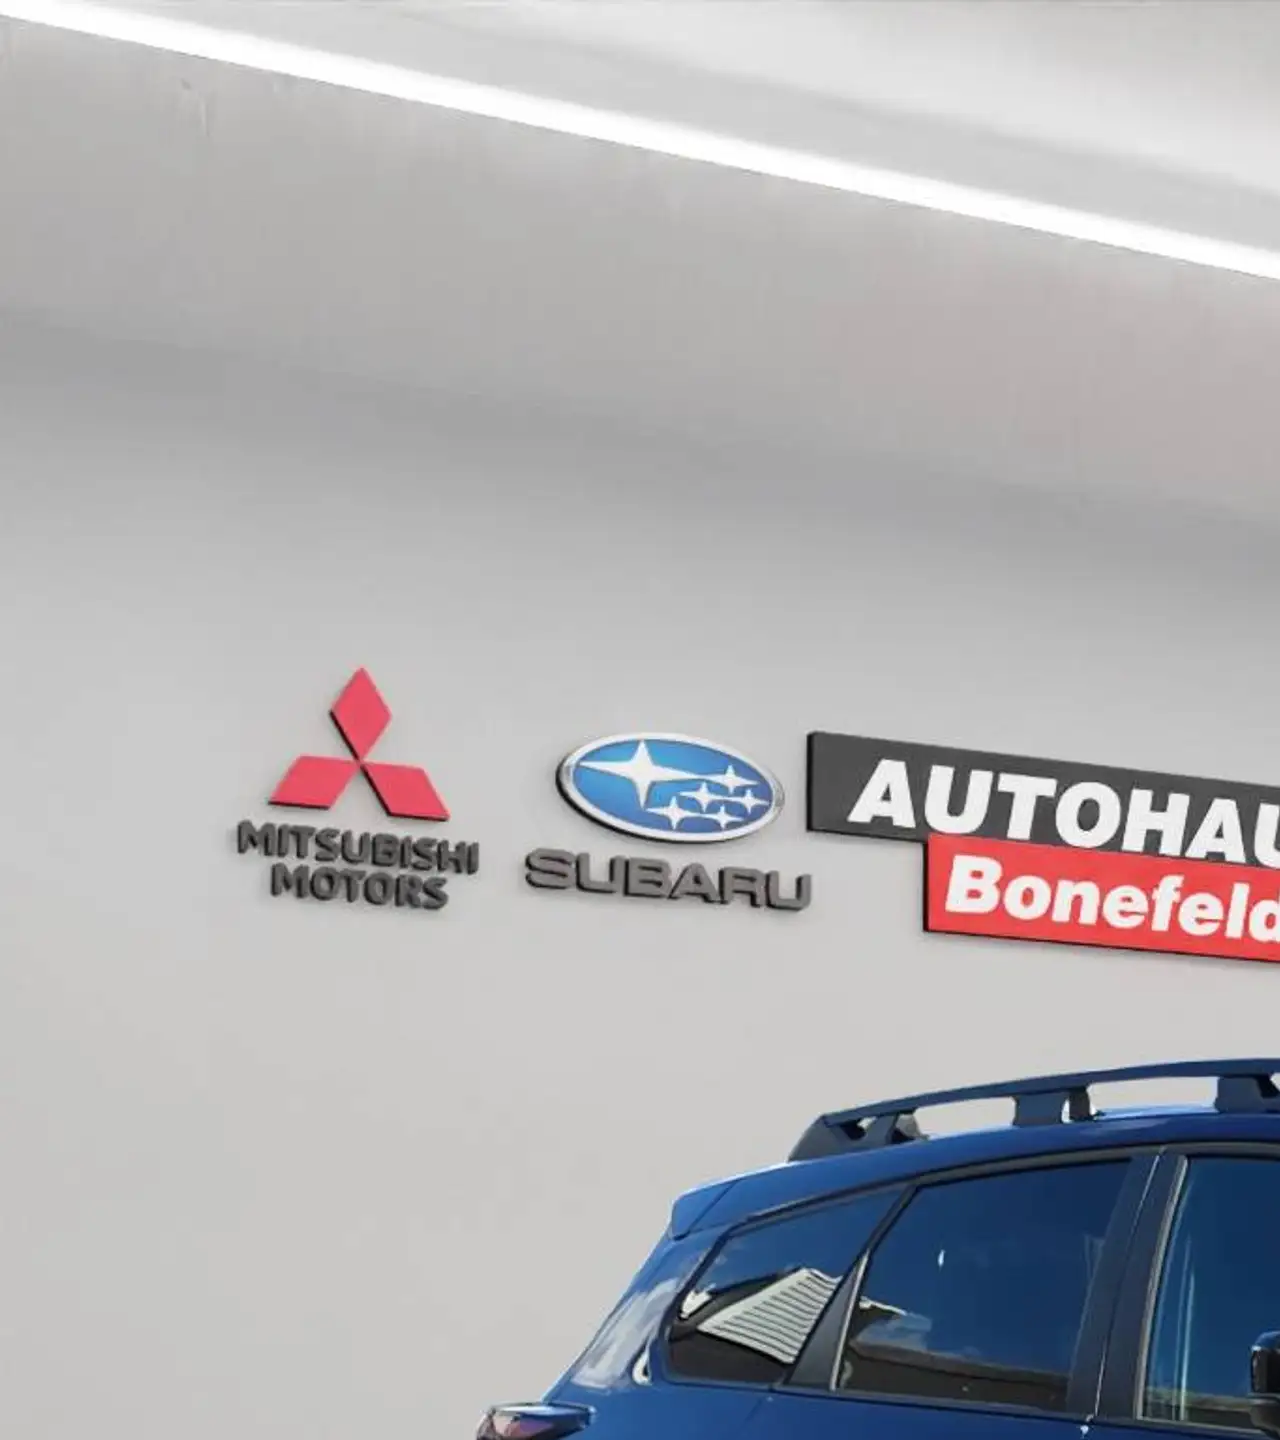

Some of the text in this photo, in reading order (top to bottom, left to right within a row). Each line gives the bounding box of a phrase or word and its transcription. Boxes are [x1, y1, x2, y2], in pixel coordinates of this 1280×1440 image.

[237, 820, 480, 876] MITSUBISHI
[270, 863, 449, 911] MOTORS
[525, 847, 813, 913] SUBARU
